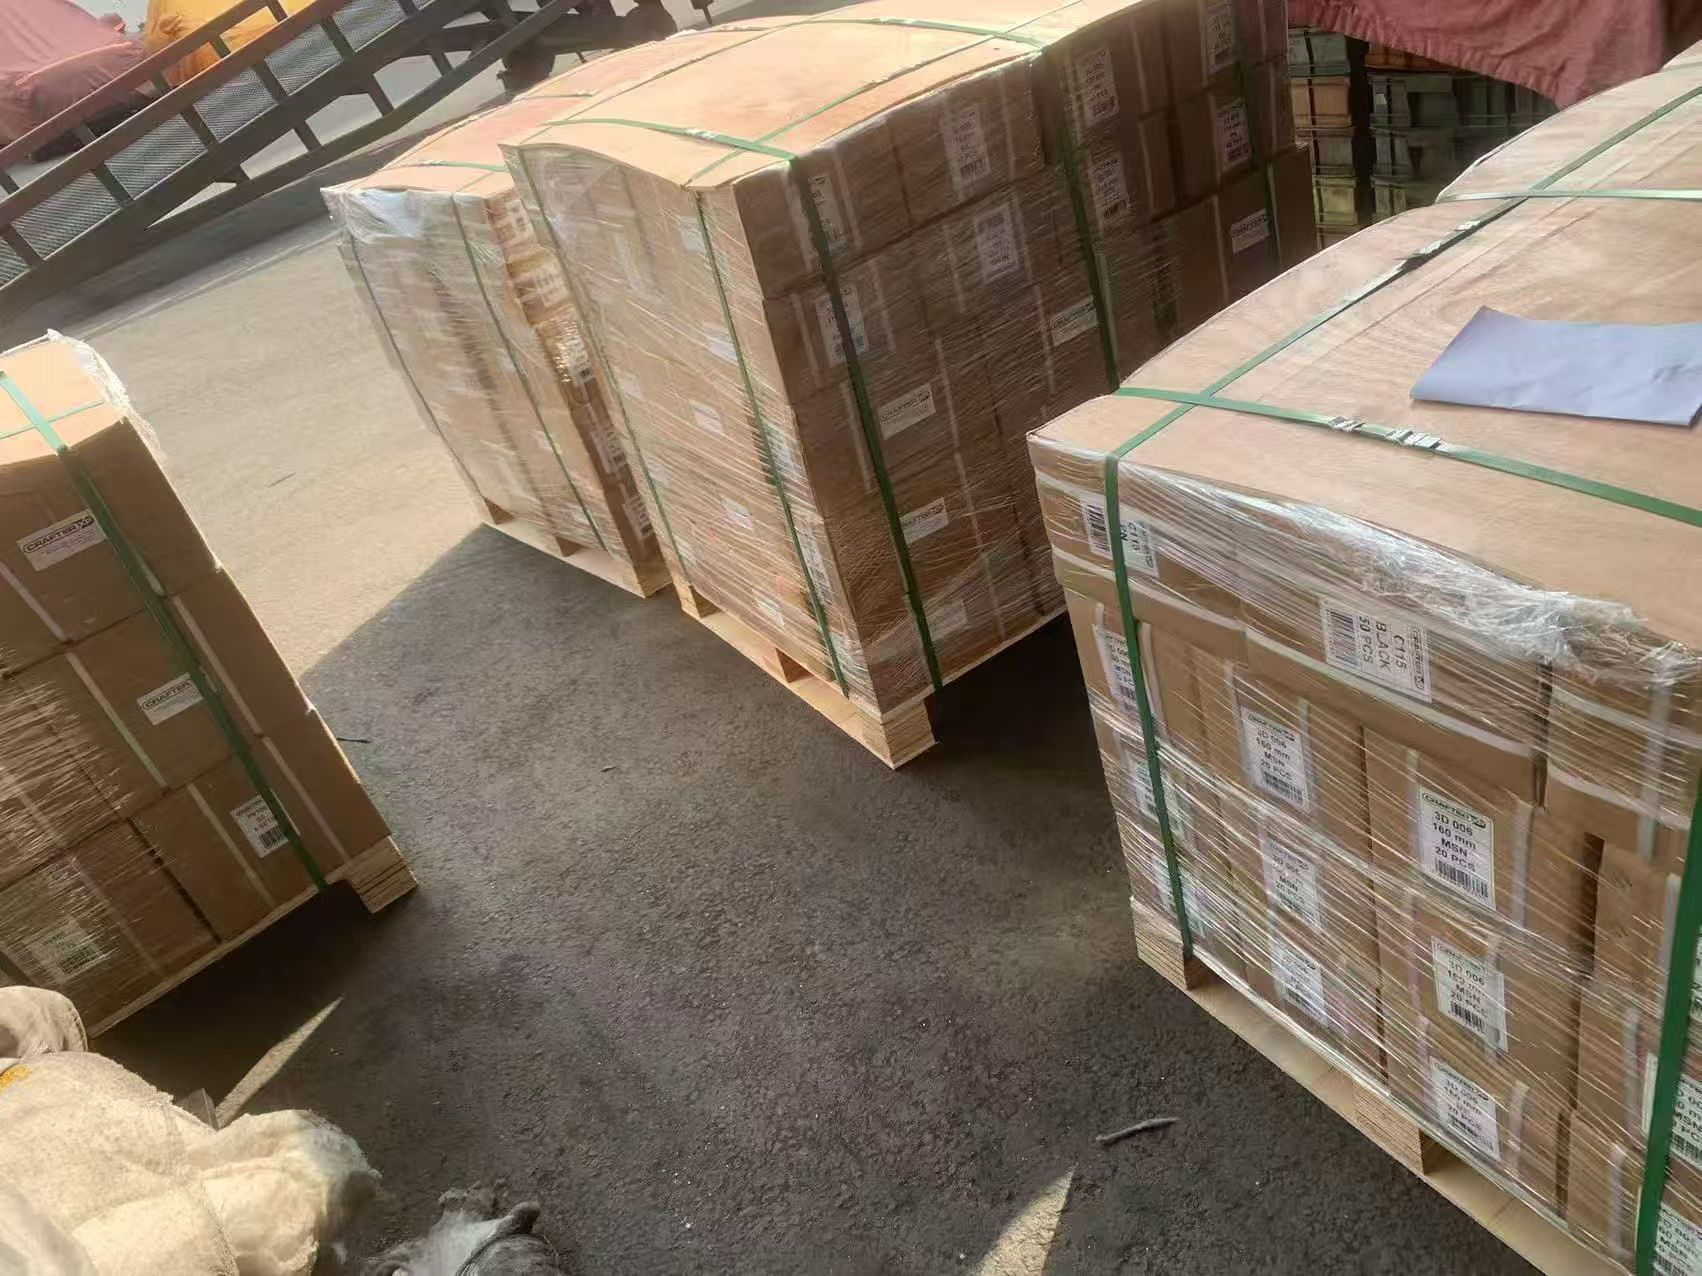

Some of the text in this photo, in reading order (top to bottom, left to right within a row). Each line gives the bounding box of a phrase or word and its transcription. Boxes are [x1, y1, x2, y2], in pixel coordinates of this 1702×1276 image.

[26, 524, 77, 552] CRAFTER
[1361, 635, 1374, 664] PCS
[1375, 620, 1391, 673] BLACK
[1393, 633, 1407, 671] C115
[146, 680, 191, 708] CRAFTER
[1432, 822, 1477, 851] 160 mm
[1433, 810, 1473, 837] 3D 006
[1435, 846, 1476, 873] 20 PCS
[1441, 837, 1468, 857] MSN
[1455, 983, 1481, 1004] MSN
